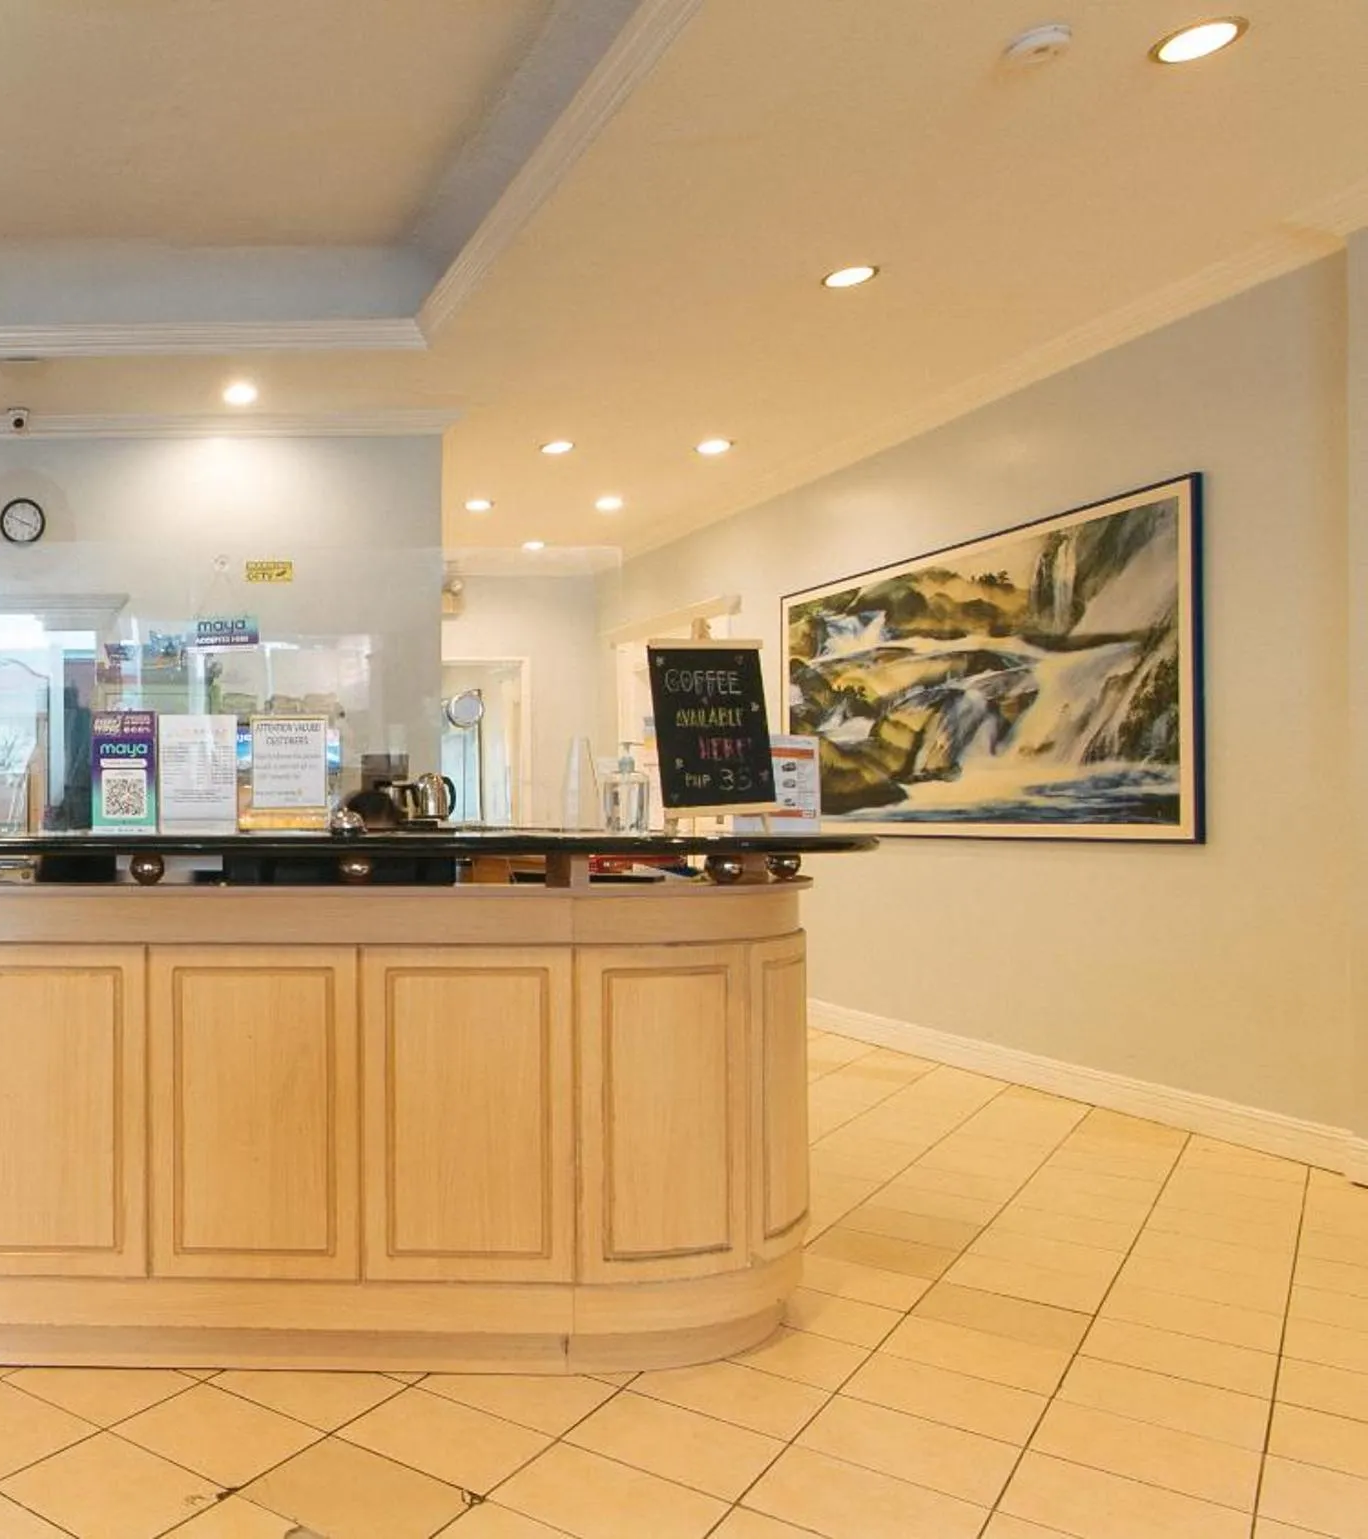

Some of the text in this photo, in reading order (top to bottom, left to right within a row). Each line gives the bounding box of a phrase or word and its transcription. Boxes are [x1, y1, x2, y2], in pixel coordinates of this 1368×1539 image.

[197, 619, 245, 634] maya
[664, 668, 742, 696] COFFEE
[676, 707, 743, 727] AVAILABLE
[256, 722, 321, 733] ATTENTION VALUED
[266, 736, 309, 746] CUSTOMERS
[99, 743, 148, 758] maya
